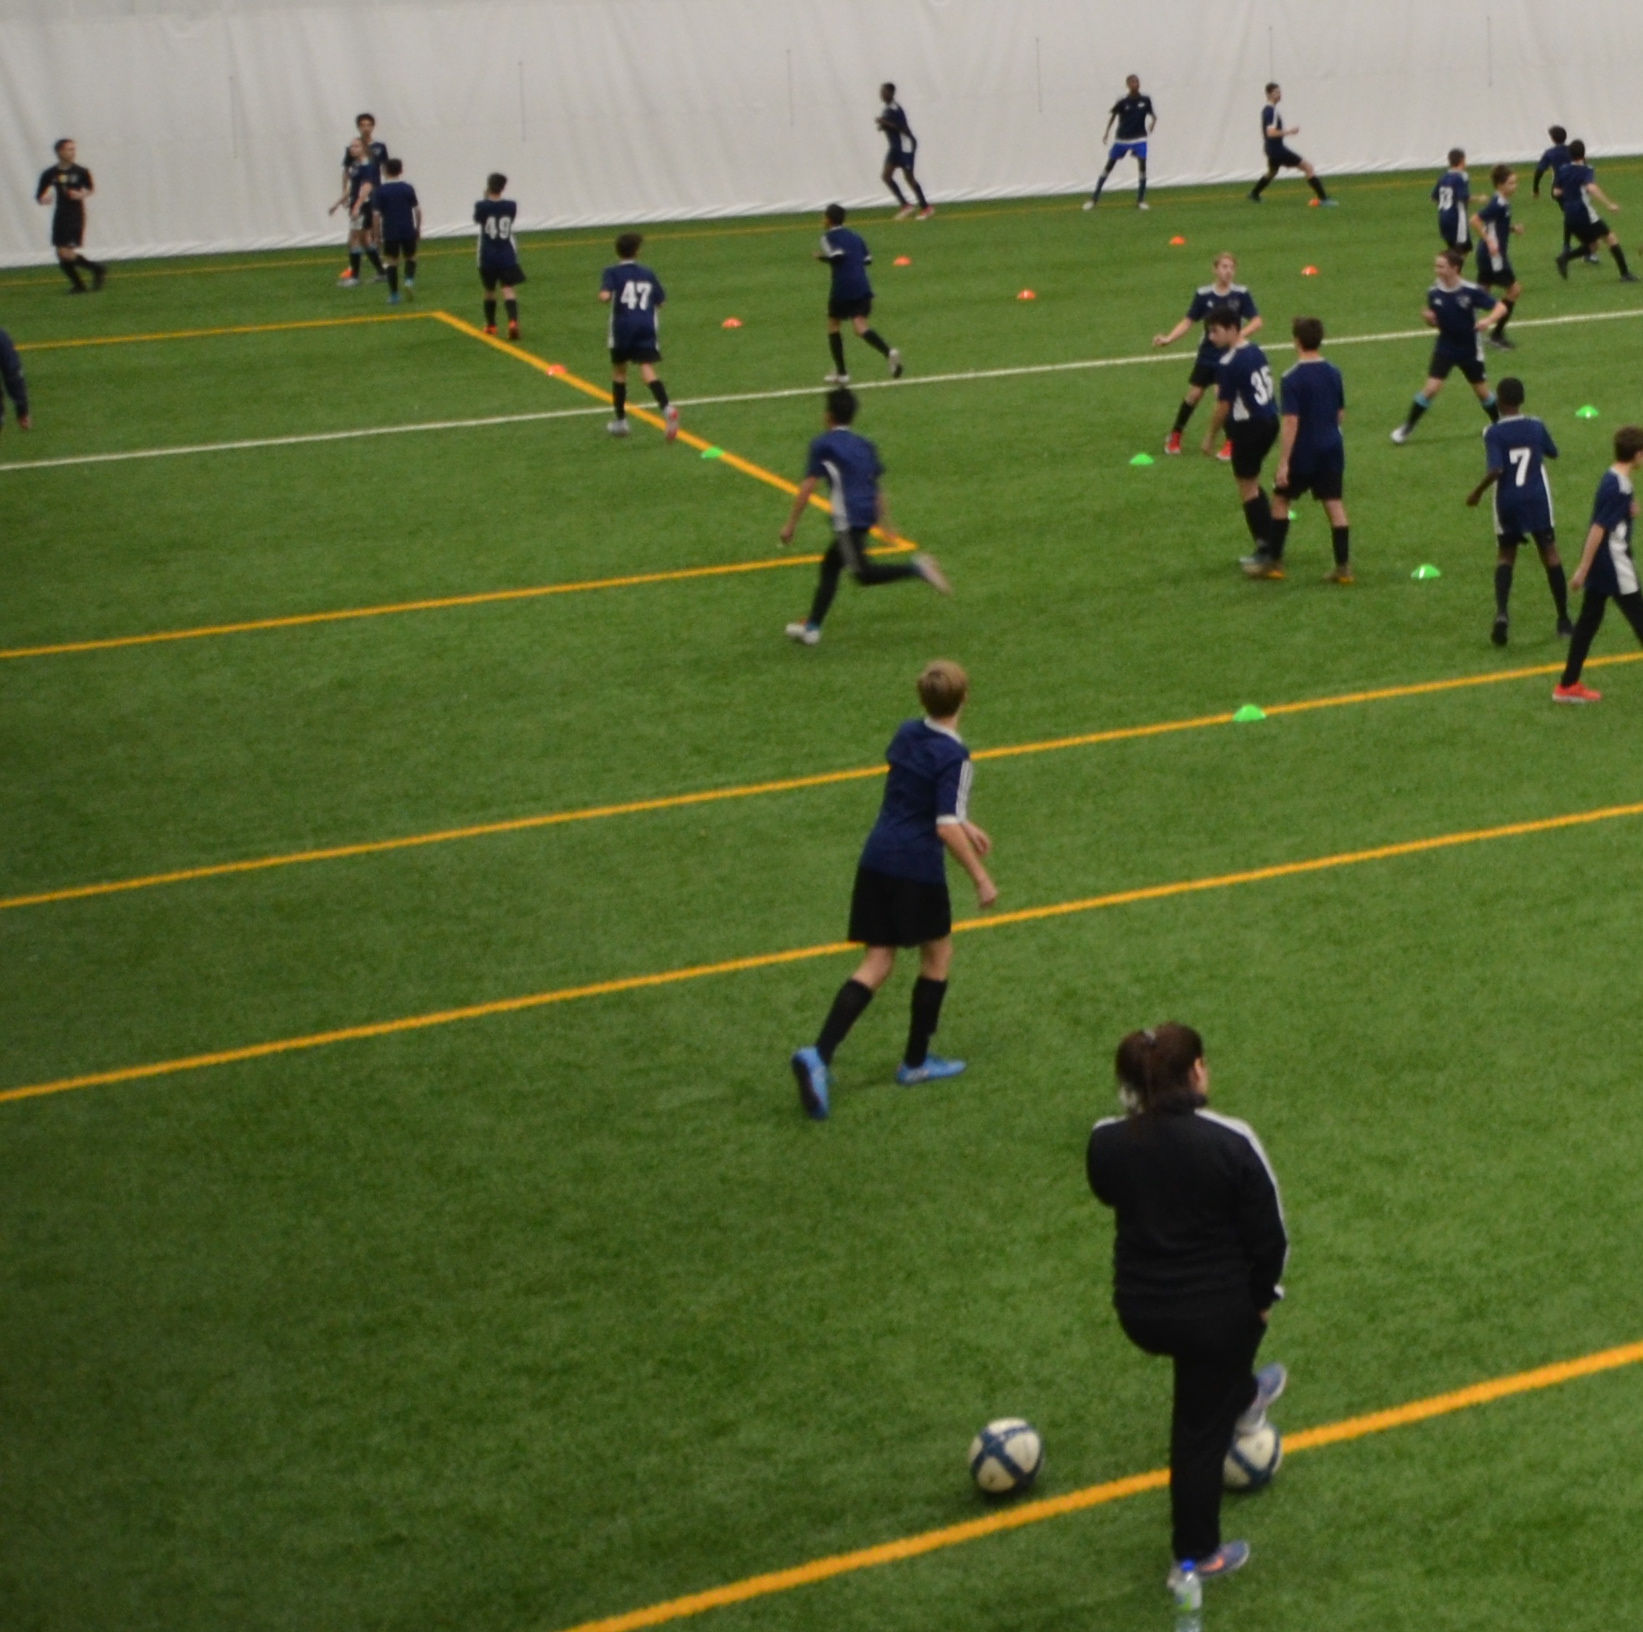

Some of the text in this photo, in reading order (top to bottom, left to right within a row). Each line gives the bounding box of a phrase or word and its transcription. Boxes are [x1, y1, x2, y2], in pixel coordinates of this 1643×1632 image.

[484, 216, 511, 240] 49
[620, 280, 652, 311] 47
[1508, 447, 1531, 487] 7
